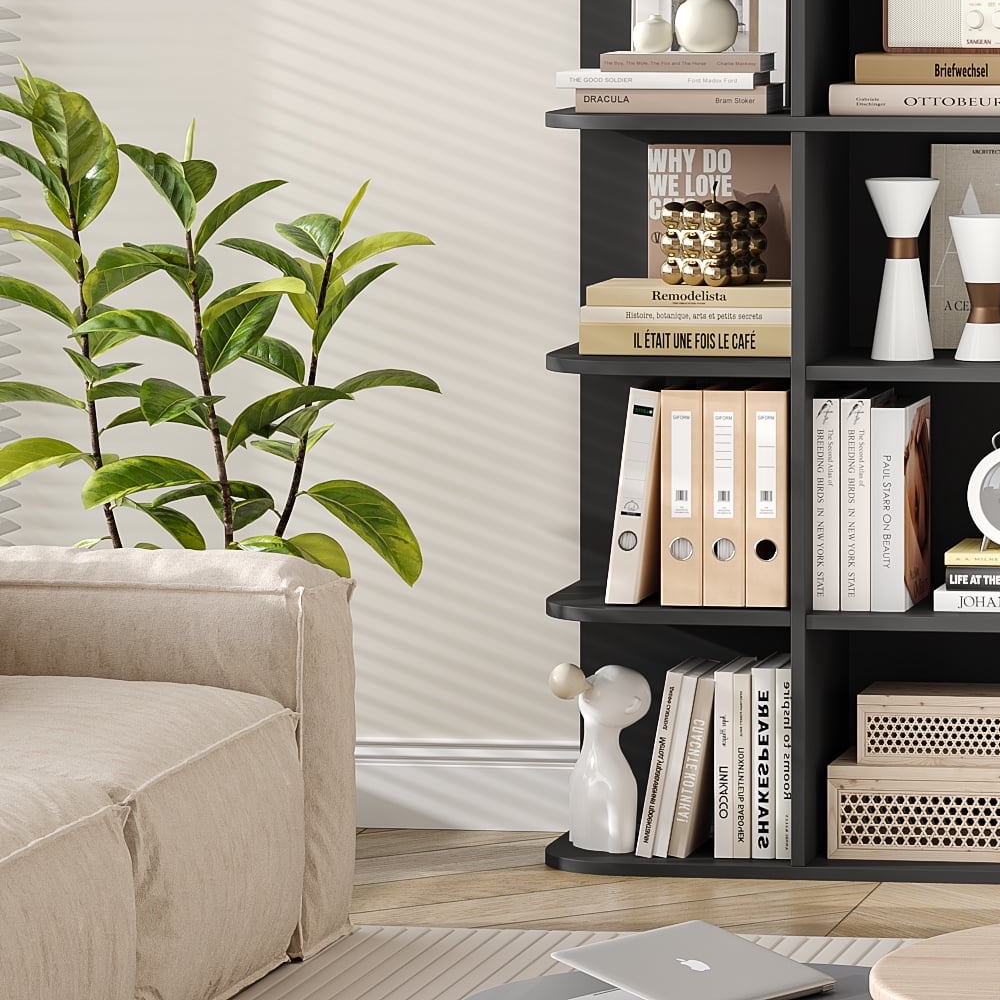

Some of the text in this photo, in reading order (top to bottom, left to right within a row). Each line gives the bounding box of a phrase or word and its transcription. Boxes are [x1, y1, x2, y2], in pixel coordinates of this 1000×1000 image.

[934, 63, 988, 78] Briefwechsel
[583, 95, 630, 104] DRACULA
[734, 97, 755, 105] Stoker
[648, 149, 731, 173] WHY DO
[648, 174, 733, 197] WE LOVE
[652, 290, 727, 301] Remodelista
[944, 301, 953, 312] A
[625, 311, 655, 320] Histoire,
[656, 312, 691, 320] botanique,
[717, 312, 736, 321] petits
[738, 313, 763, 321] secrets
[633, 329, 756, 350] IL ÉTAIT UNE FOIS LE CAFÉ
[827, 479, 834, 487] of
[816, 429, 824, 598] BREEDING BIRDS IN NEW YORK STATE
[848, 508, 855, 517] IN
[883, 455, 892, 569] PAUL STARR ON BEAUTY
[950, 574, 969, 585] LIFE
[970, 575, 982, 585] AT
